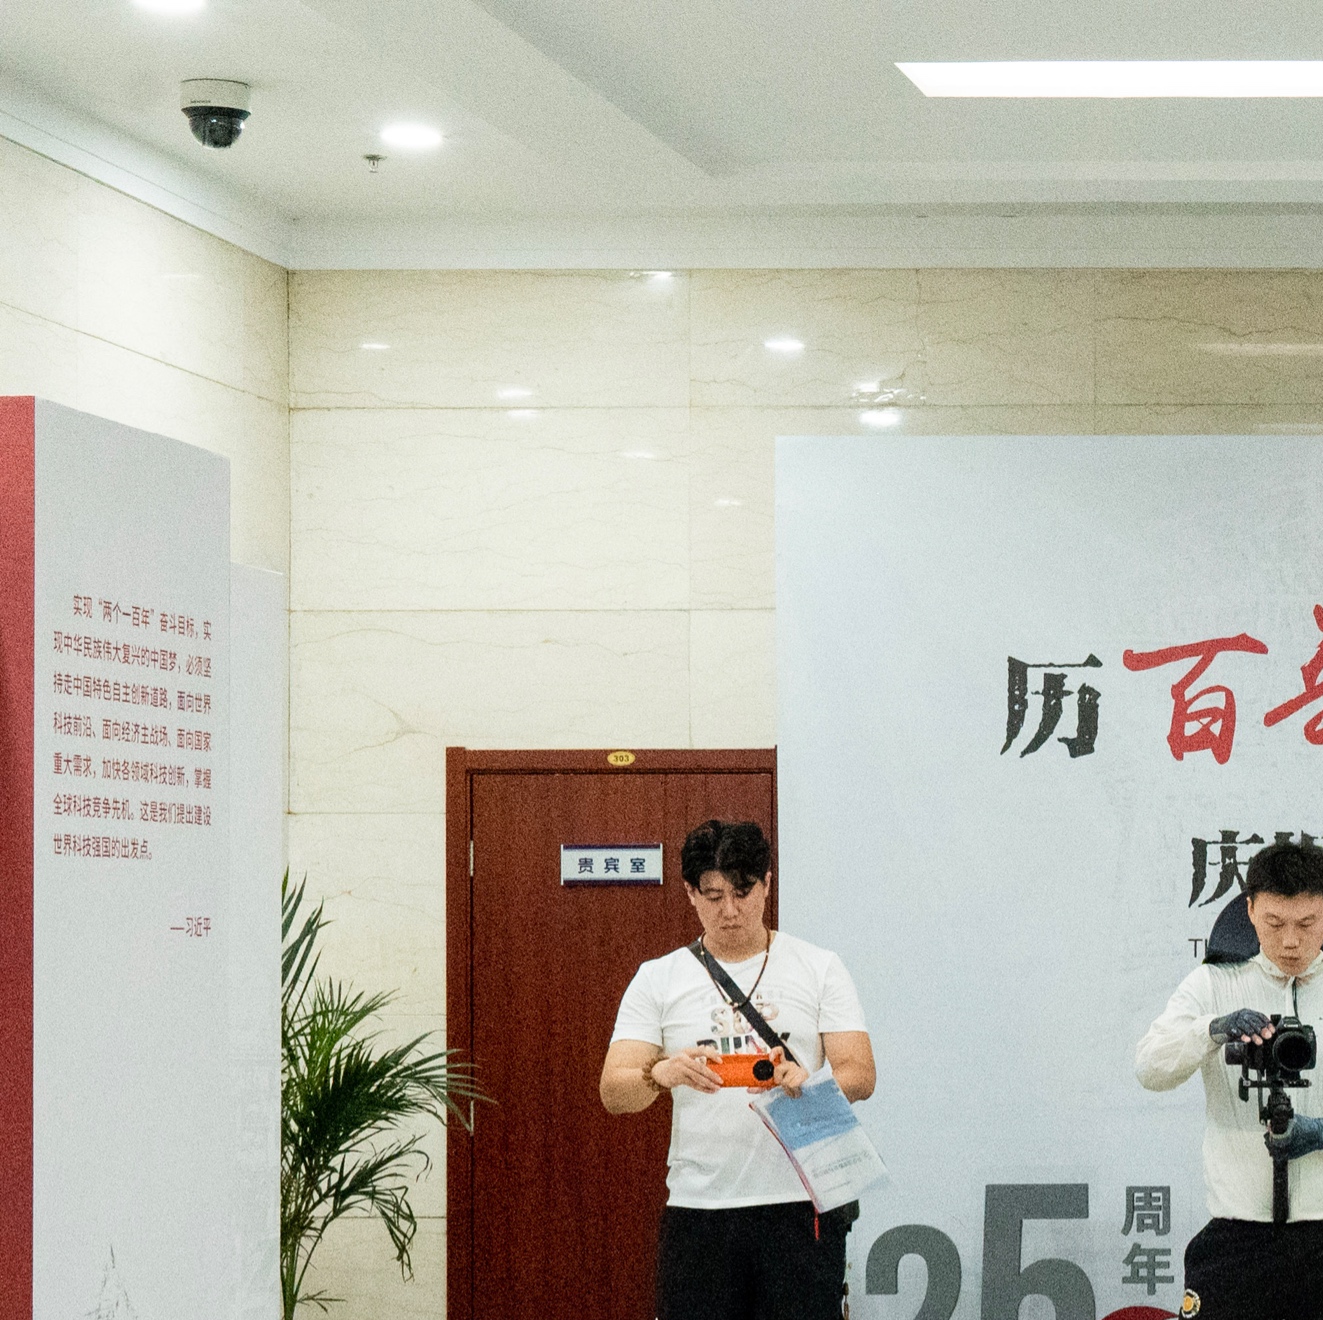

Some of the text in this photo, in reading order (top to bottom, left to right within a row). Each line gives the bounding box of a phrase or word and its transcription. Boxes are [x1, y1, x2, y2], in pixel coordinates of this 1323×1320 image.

[613, 754, 630, 762] 303
[577, 857, 646, 874] 贵宾室
[1121, 1185, 1175, 1296] 周年
